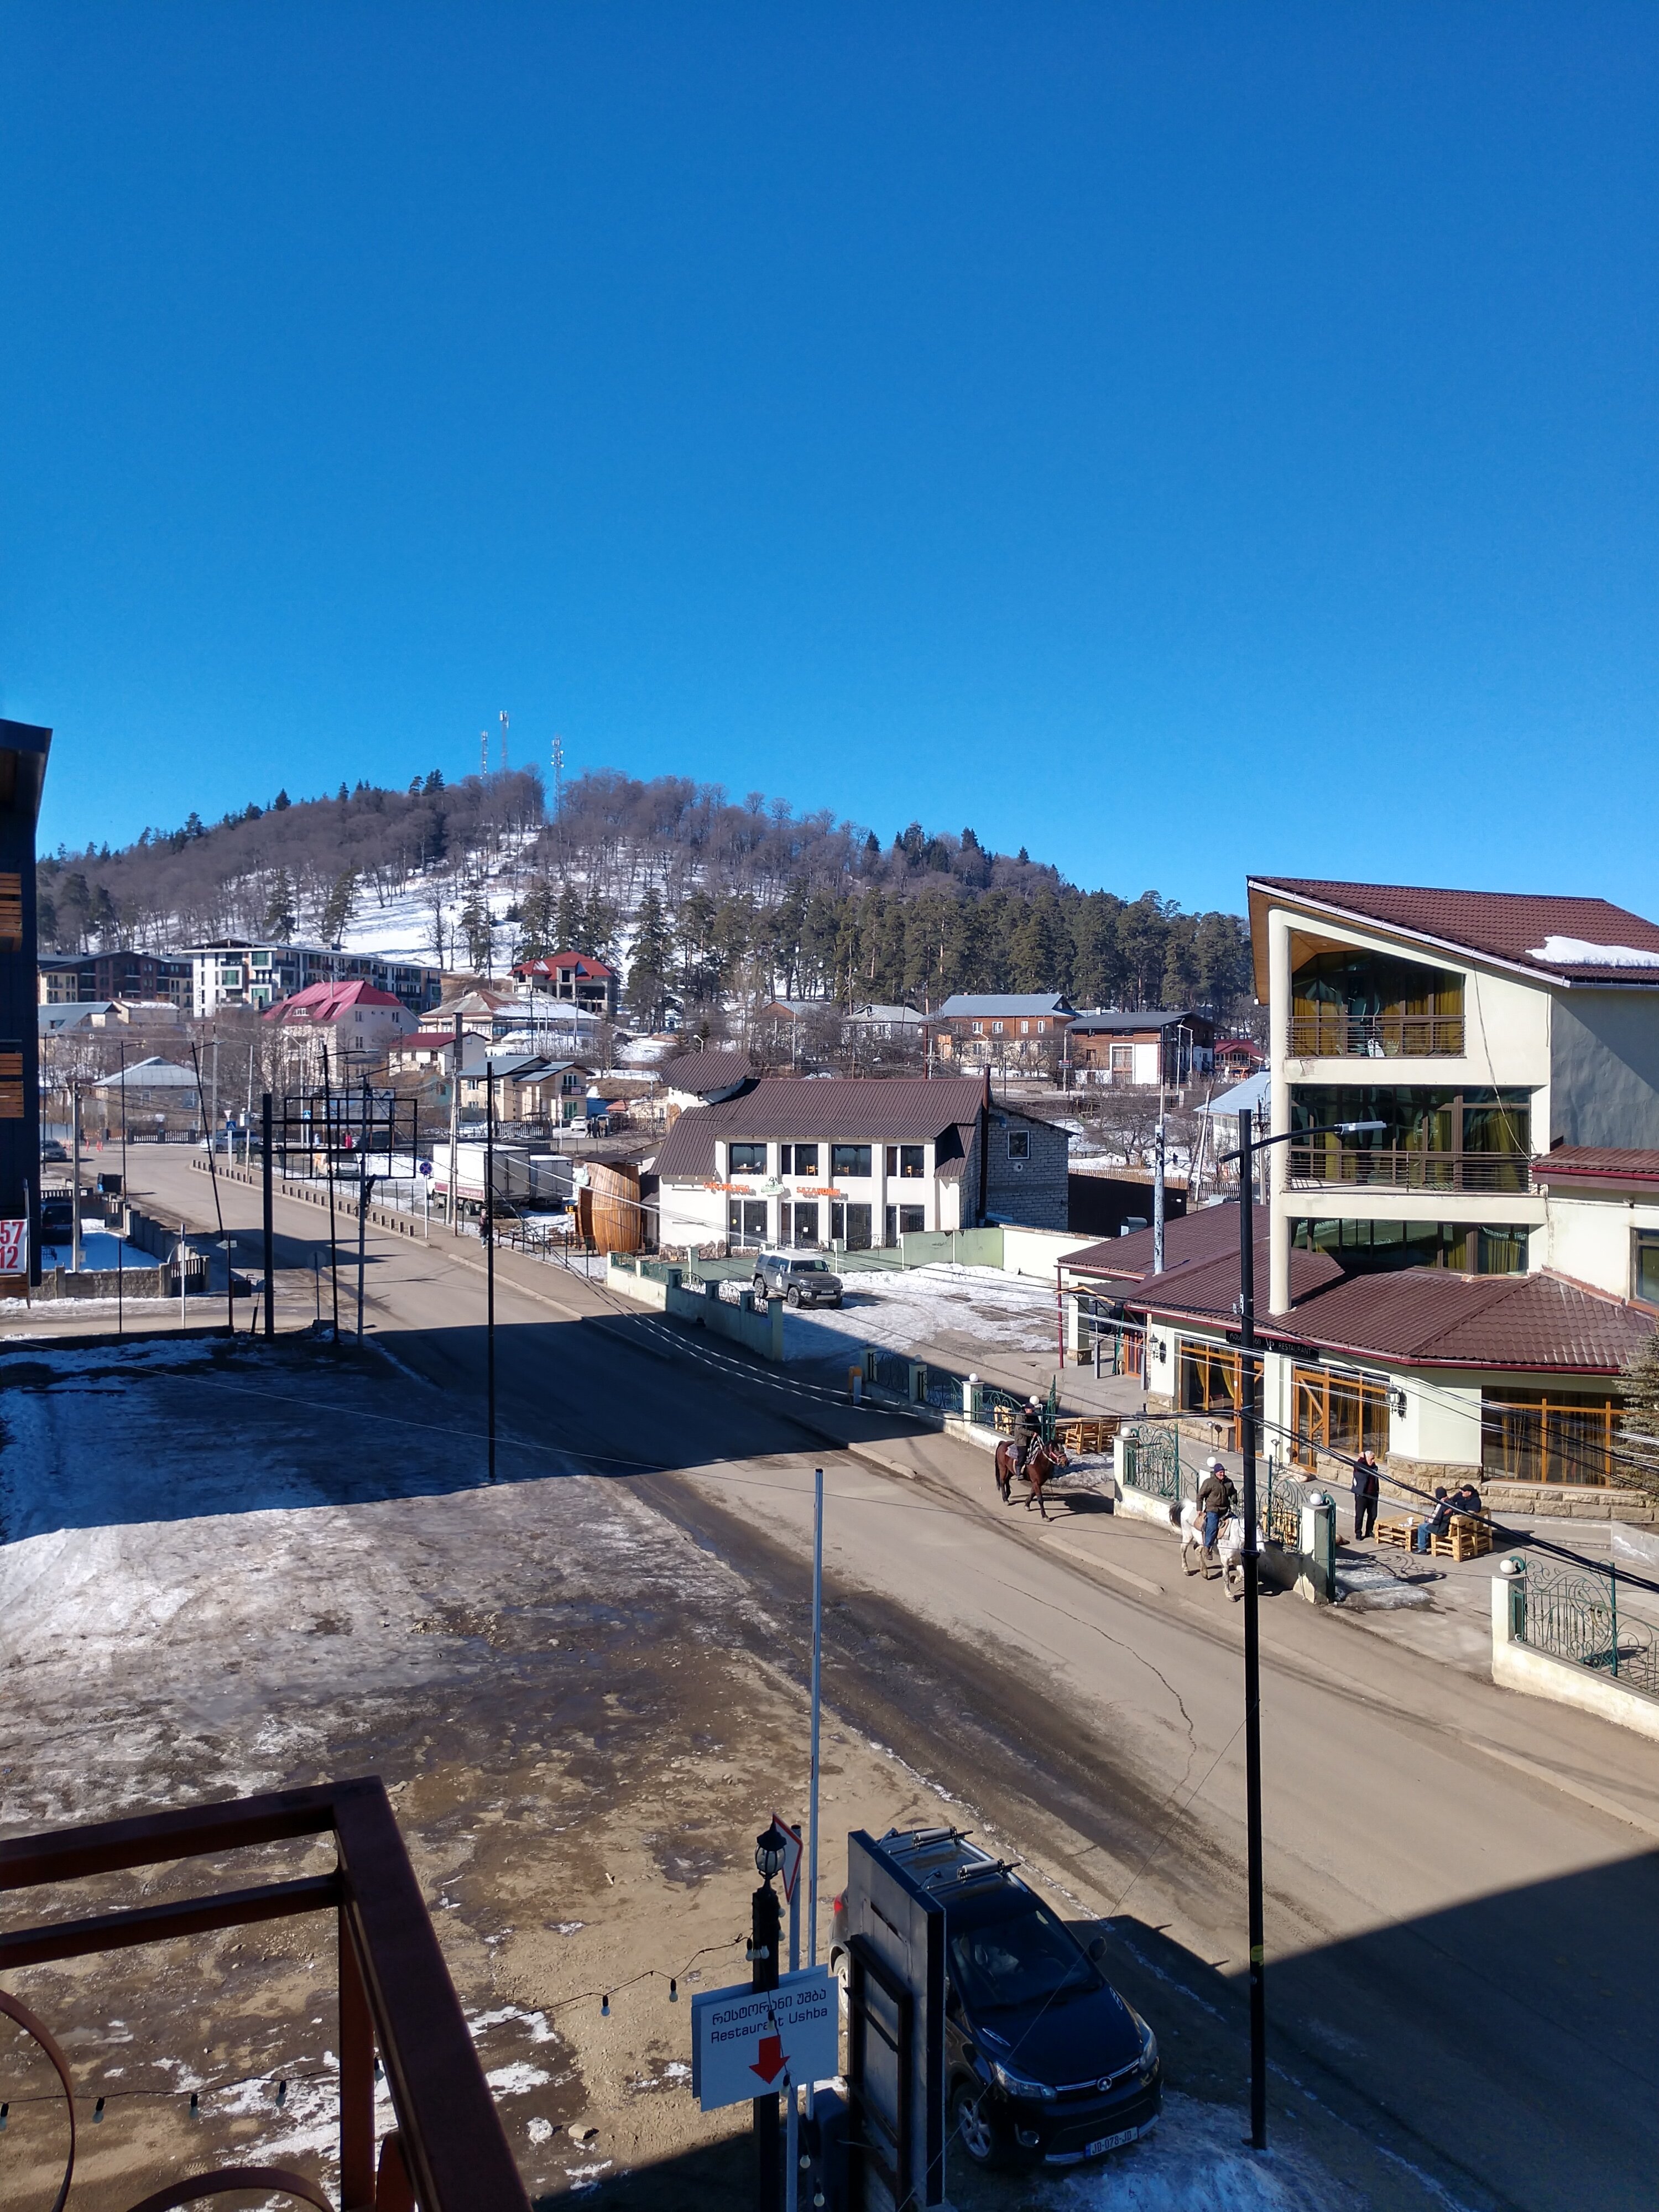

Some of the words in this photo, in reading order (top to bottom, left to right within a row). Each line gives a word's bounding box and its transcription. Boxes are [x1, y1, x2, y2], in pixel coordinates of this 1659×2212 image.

[0, 1221, 24, 1244] 57
[0, 1245, 18, 1269] 12
[1279, 1342, 1311, 1355] RESTAURANT
[711, 2017, 784, 2043] Restaurat
[789, 2007, 827, 2023] Ushba
[1092, 2131, 1131, 2153] JD-078-JD
